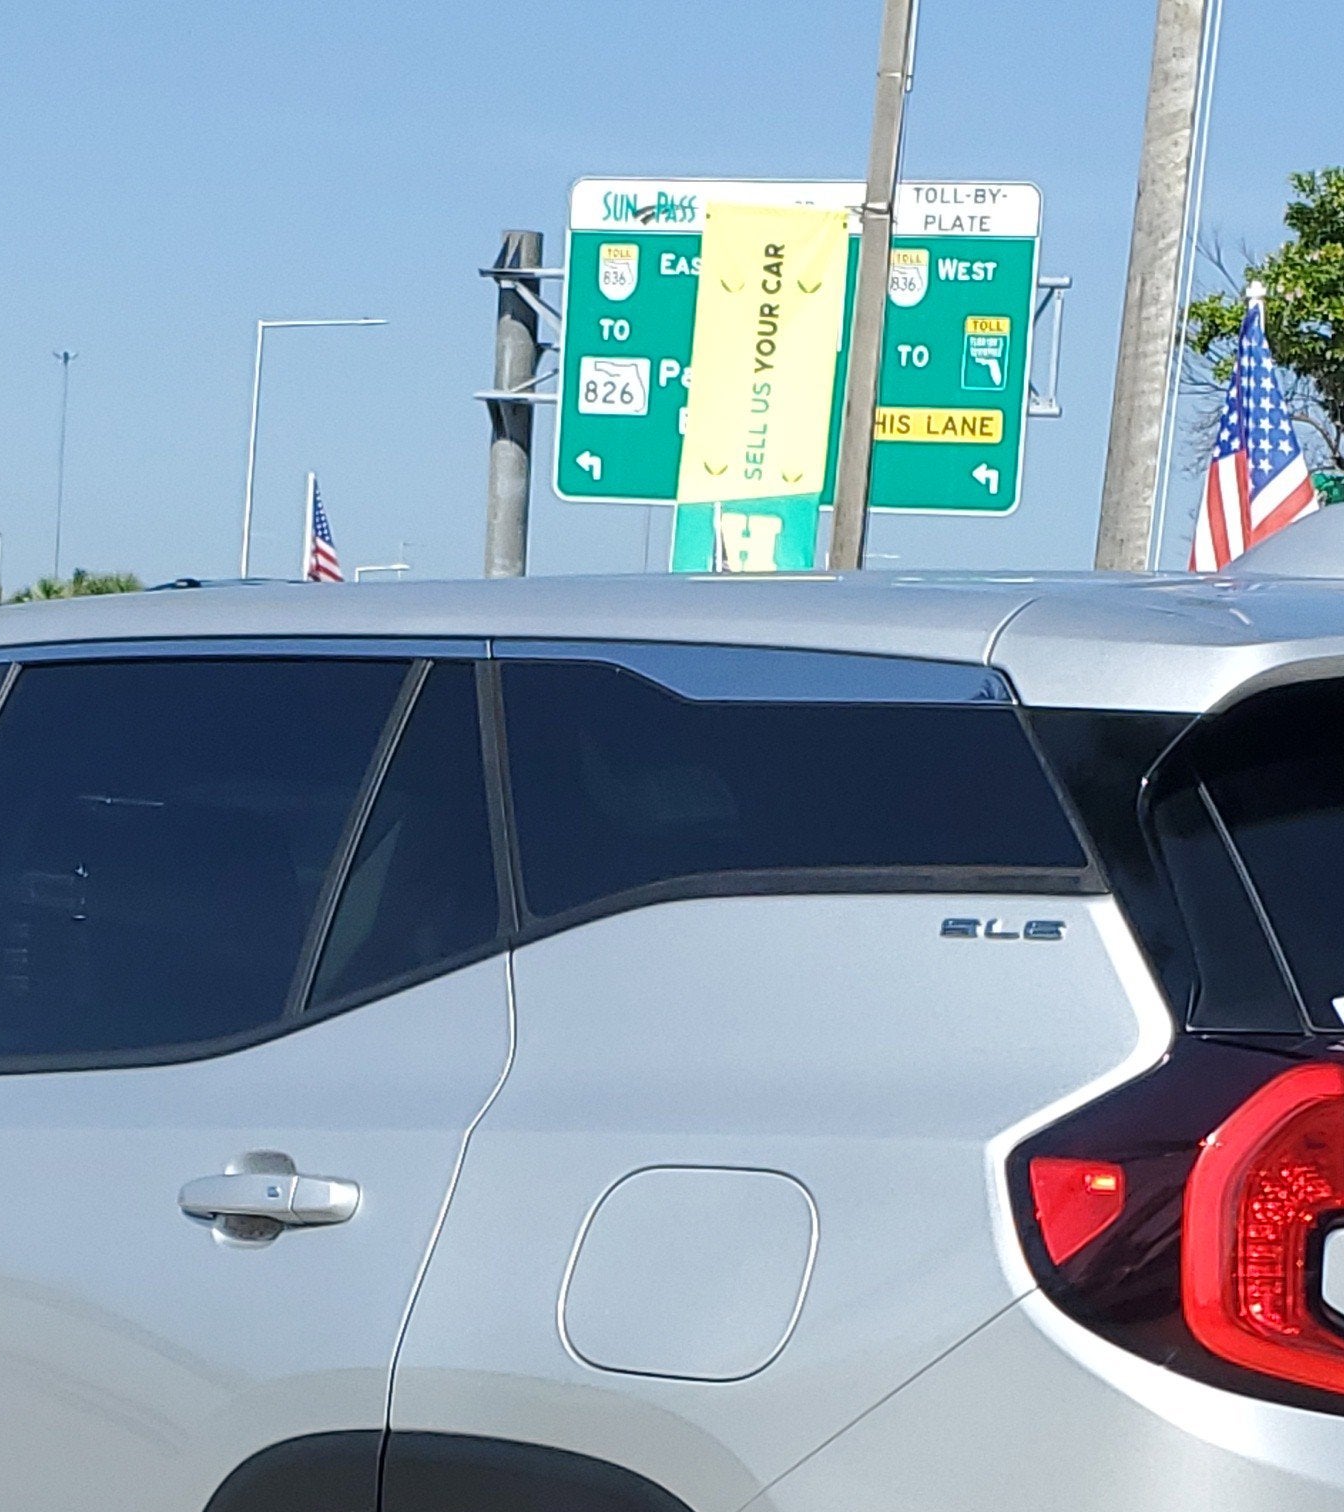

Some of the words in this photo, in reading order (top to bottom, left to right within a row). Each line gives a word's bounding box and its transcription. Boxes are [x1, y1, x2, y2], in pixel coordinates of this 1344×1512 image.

[913, 187, 1008, 204] TOLL-BY-
[923, 214, 992, 232] PLATE
[607, 248, 632, 258] TOLL
[660, 252, 703, 275] EAS
[896, 253, 922, 264] TOLL
[603, 270, 626, 286] 836
[761, 242, 786, 295] CAR
[937, 257, 998, 281] WEST
[599, 318, 630, 341] TO
[972, 320, 1004, 332] TOLL
[753, 302, 780, 374] YOUR
[897, 344, 930, 368] TO
[584, 380, 634, 405] 826
[750, 382, 772, 414] US
[875, 414, 911, 435] HIS
[926, 415, 994, 437] LANE
[744, 423, 768, 481] SELL
[939, 917, 1068, 941] SLE
